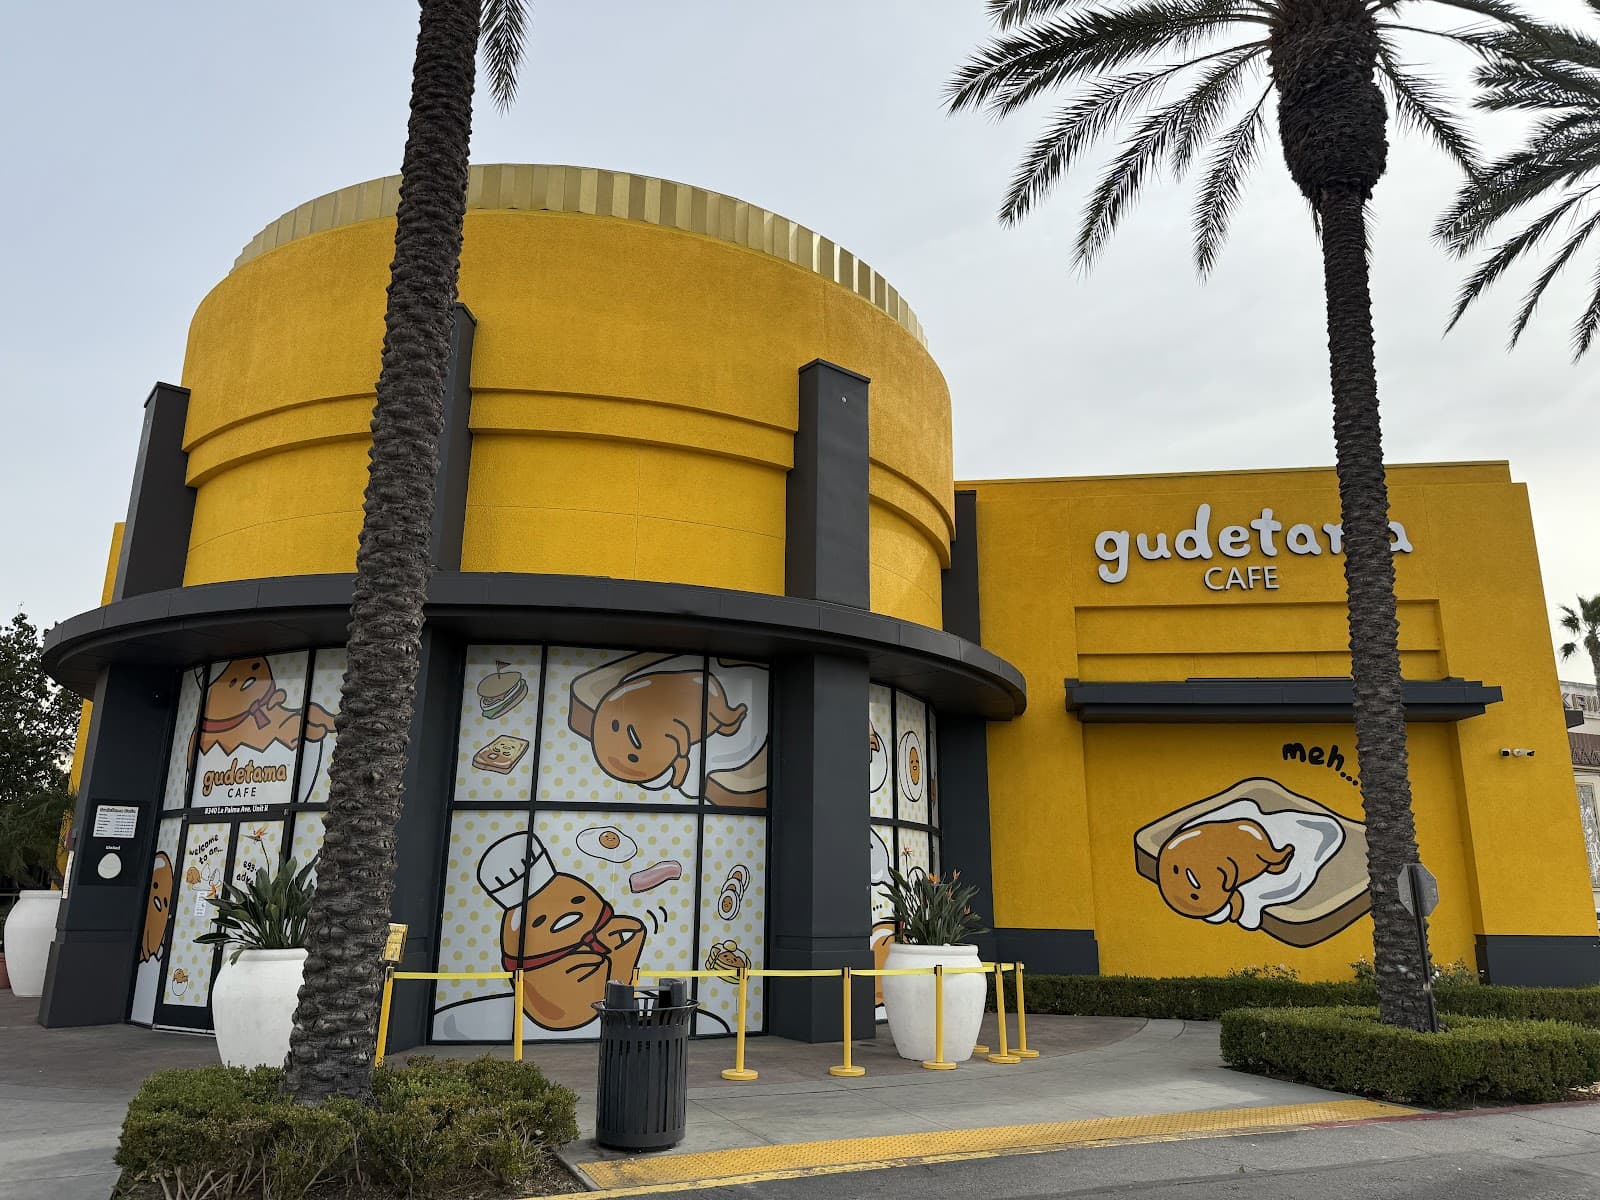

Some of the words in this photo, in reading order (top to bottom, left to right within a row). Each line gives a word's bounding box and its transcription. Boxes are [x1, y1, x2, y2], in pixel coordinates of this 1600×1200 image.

[1203, 565, 1280, 591] CAFE
[202, 757, 287, 797] gudetama
[227, 786, 257, 798] CAFE
[224, 805, 240, 814] Palma
[252, 804, 264, 812] Unit
[189, 834, 219, 856] welcome
[199, 854, 208, 865] to
